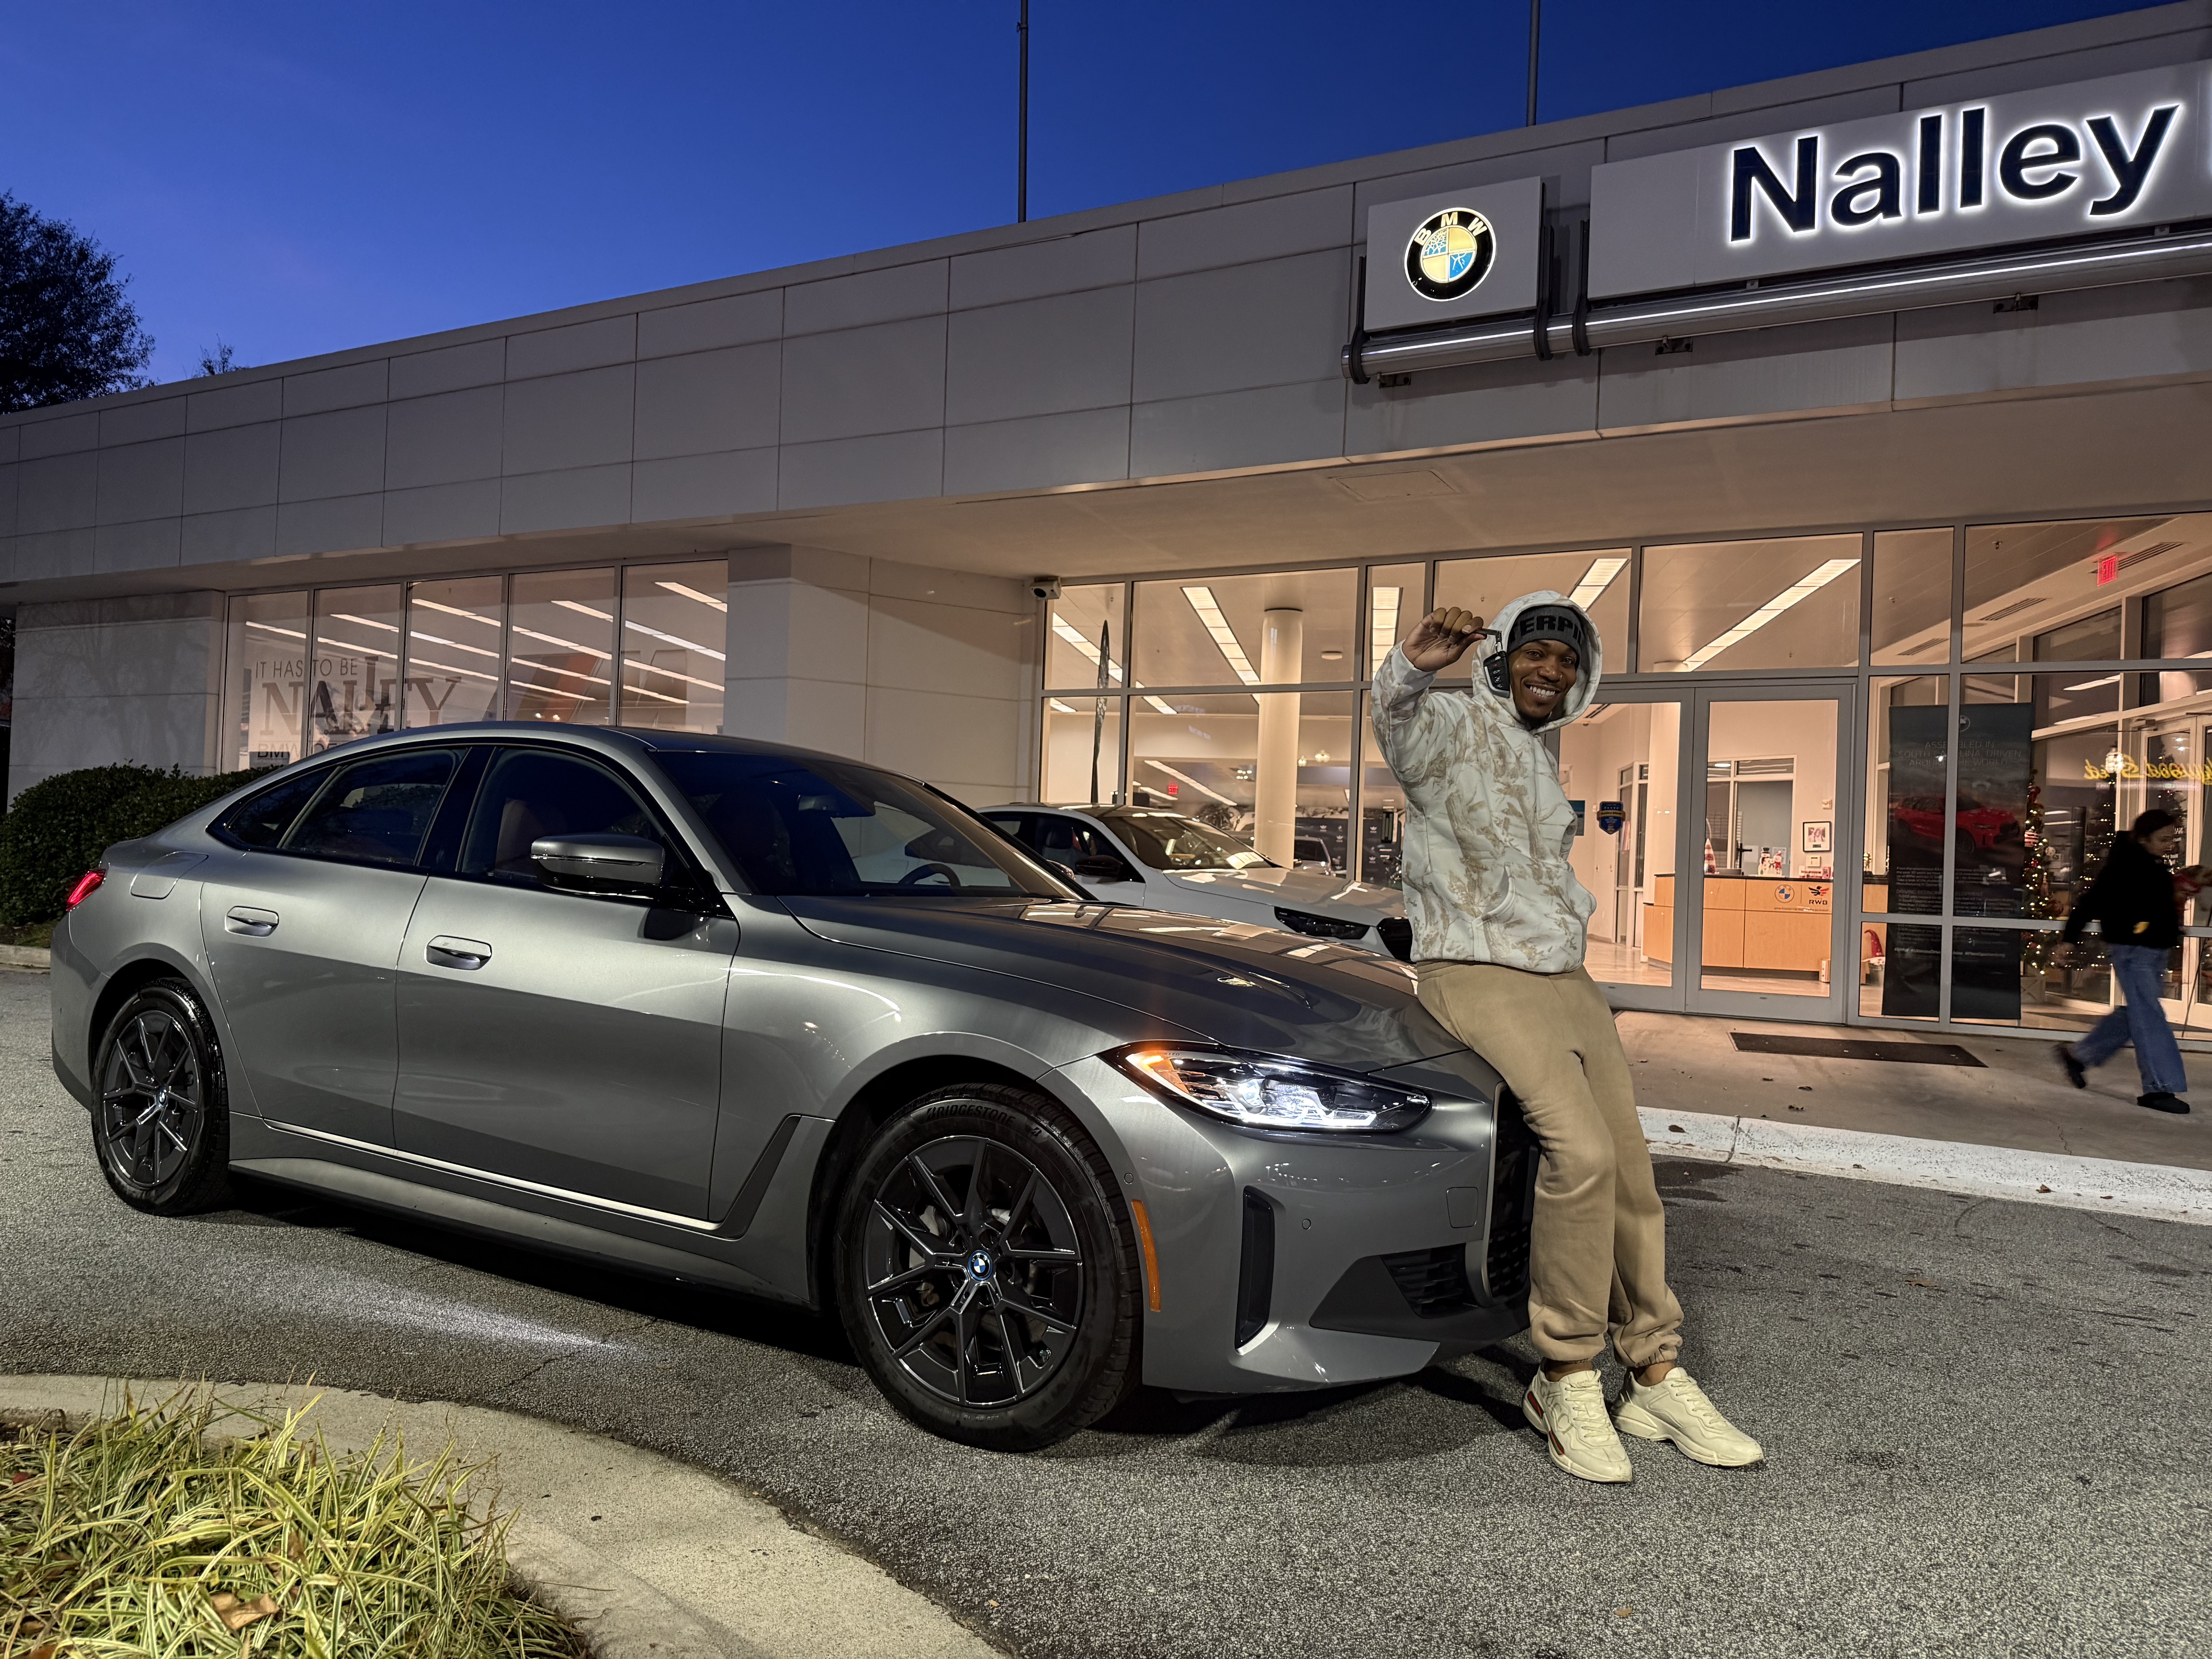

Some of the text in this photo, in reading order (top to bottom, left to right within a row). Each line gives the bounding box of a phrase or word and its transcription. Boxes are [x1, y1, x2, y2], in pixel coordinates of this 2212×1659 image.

[1730, 104, 2180, 243] Nalley
[1413, 211, 1488, 246] BMW
[256, 658, 358, 679] IT HAS TO BE
[258, 742, 301, 758] BMW
[926, 1104, 1016, 1125] BRIDGESTONE
